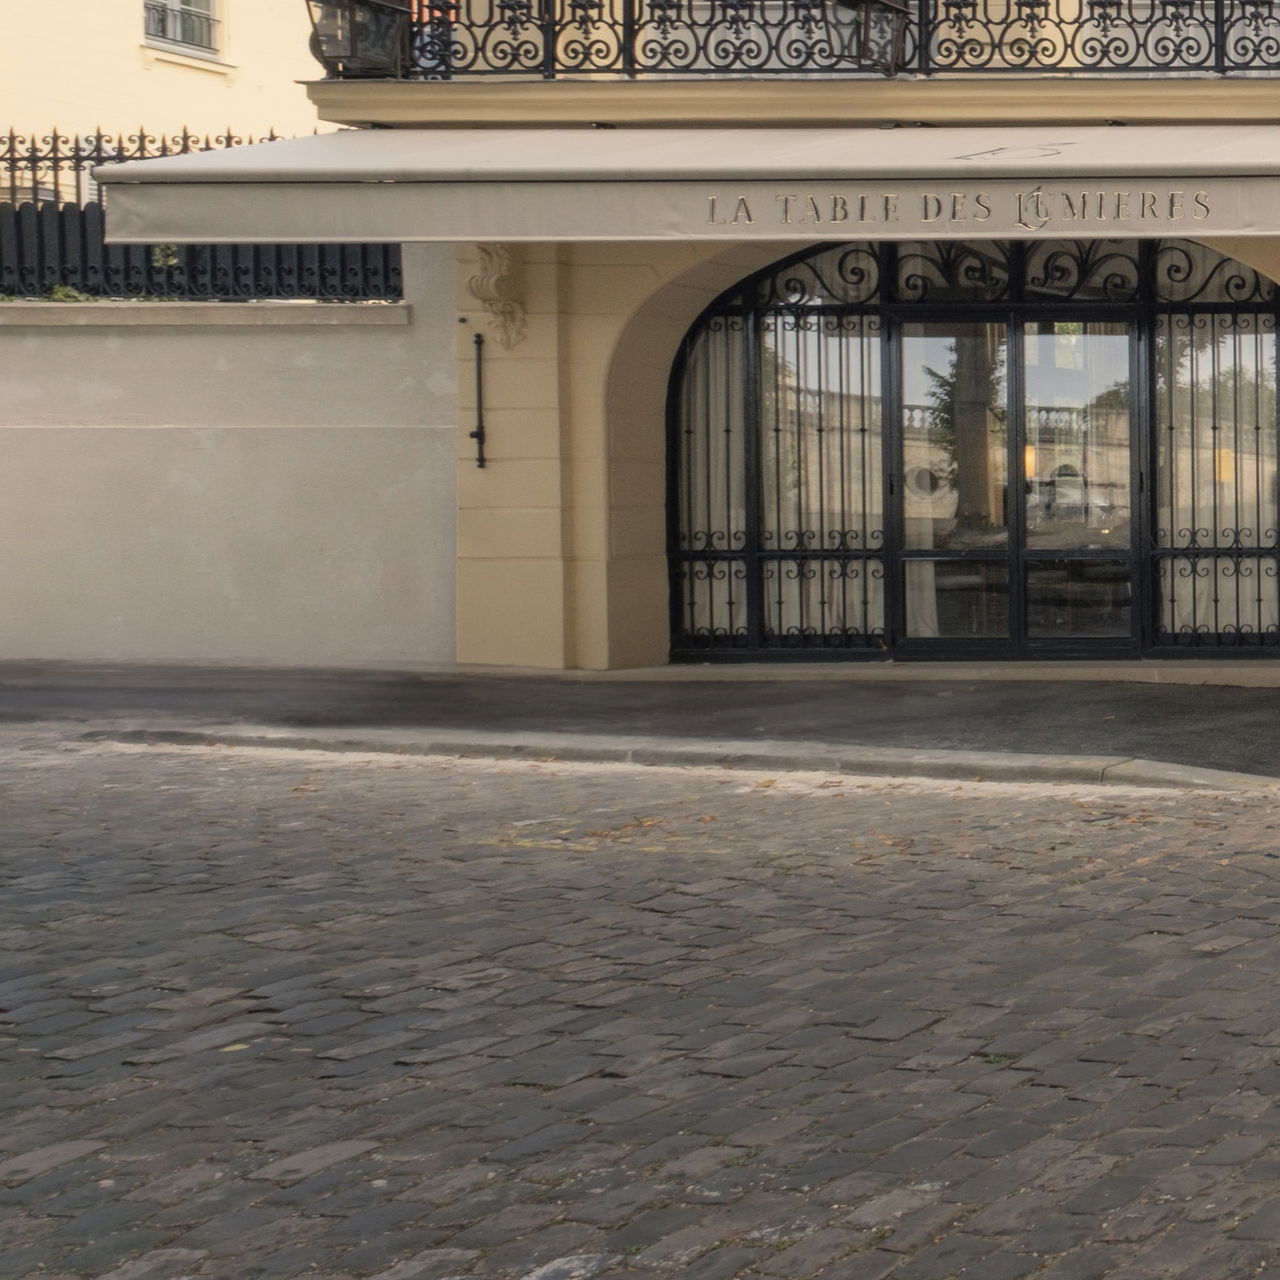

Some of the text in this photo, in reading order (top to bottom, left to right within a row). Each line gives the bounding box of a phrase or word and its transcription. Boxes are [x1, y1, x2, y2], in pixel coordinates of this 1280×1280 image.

[707, 195, 754, 224] LA
[776, 193, 899, 224] TABLE
[920, 191, 992, 222] DES
